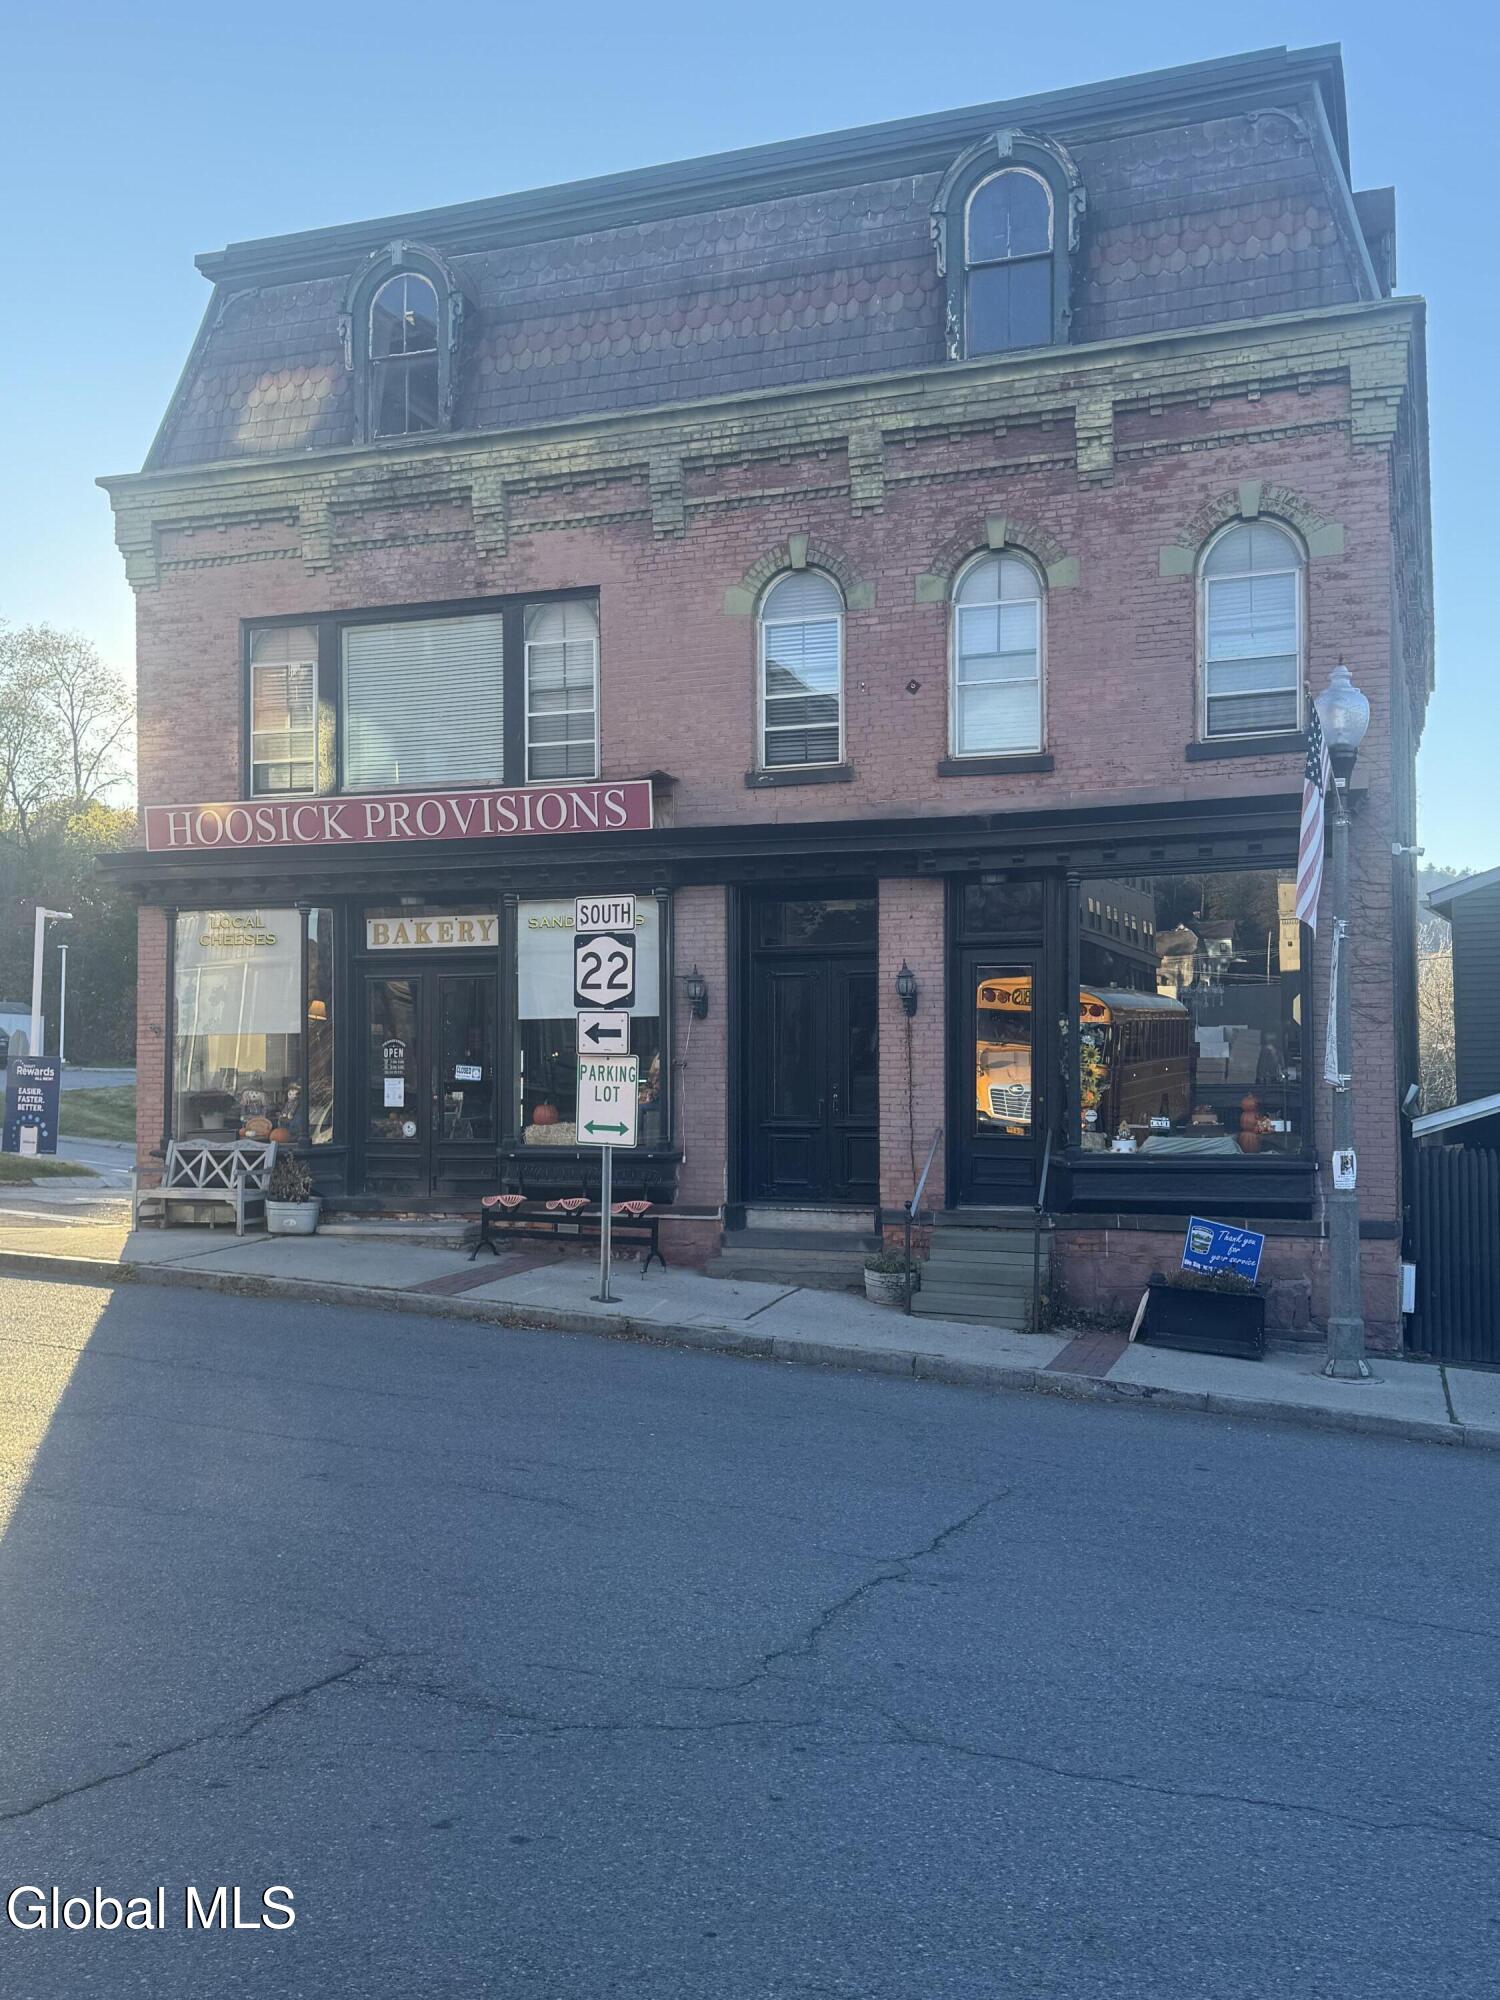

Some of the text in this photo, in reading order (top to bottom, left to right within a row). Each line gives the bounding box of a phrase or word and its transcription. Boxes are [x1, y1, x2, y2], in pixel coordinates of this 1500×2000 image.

[166, 789, 628, 847] HOOSICK PROVISIONS
[580, 903, 631, 925] SOUTH
[210, 915, 266, 929] LOCAL
[371, 919, 495, 945] BAKERY
[199, 934, 277, 946] CHEESES
[580, 951, 629, 990] 22
[383, 1047, 404, 1058] OPEN
[17, 1066, 54, 1076] Rewards
[580, 1064, 636, 1083] PARKING
[18, 1087, 43, 1095] EASIER.
[594, 1086, 620, 1103] LOT
[17, 1095, 45, 1104] FASTER.
[1218, 1230, 1243, 1242] Thank
[1241, 1238, 1256, 1248] you
[1228, 1244, 1240, 1255] for
[1229, 1257, 1256, 1265] service
